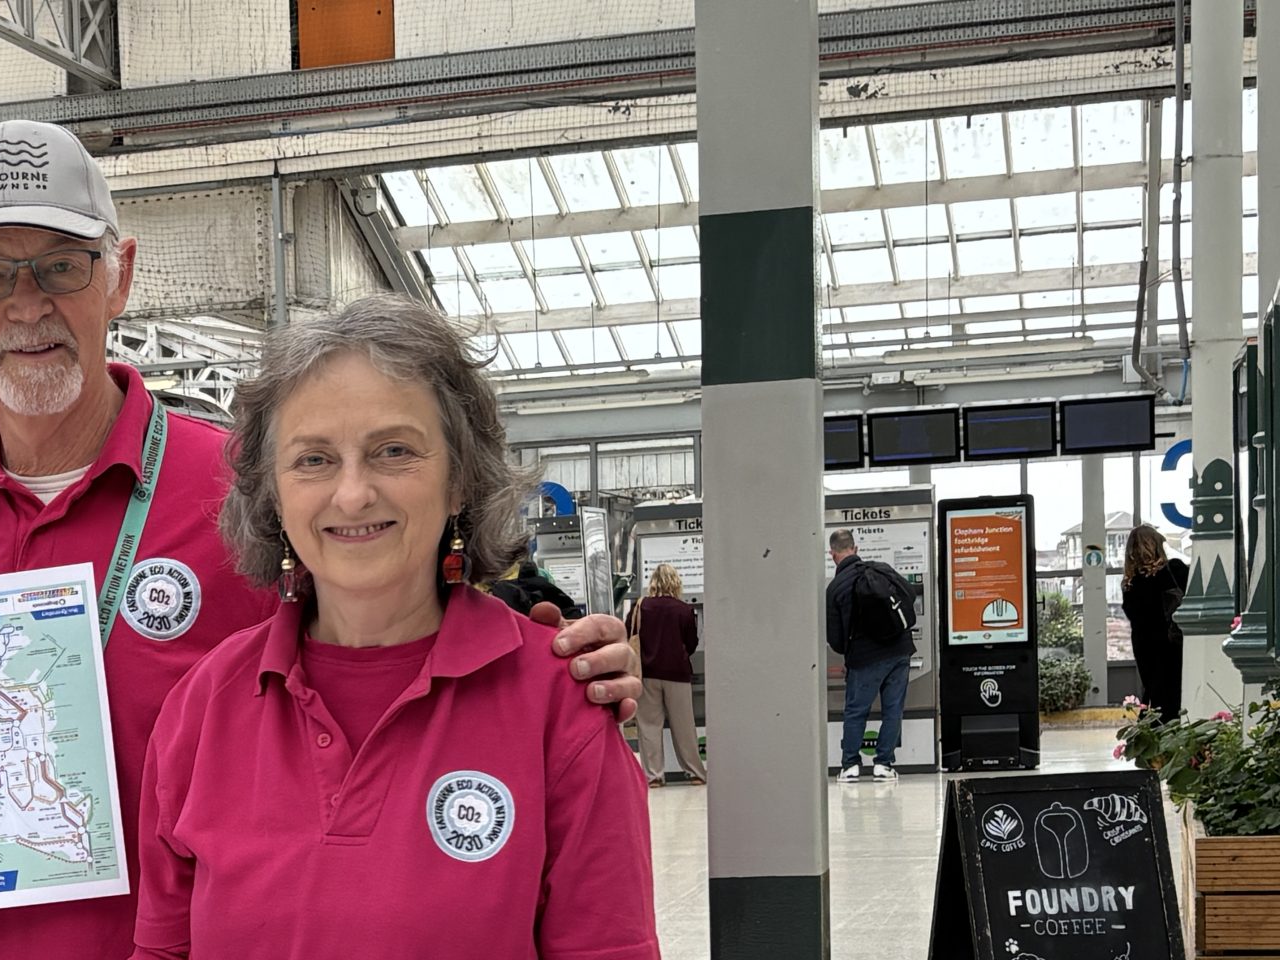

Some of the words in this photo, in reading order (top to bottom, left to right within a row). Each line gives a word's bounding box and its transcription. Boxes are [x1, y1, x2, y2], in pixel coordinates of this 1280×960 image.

[143, 435, 161, 485] EASTBOURNE
[676, 518, 703, 531] Tick
[841, 509, 891, 521] Tickets
[954, 528, 984, 536] Clapham
[985, 526, 1013, 534] Junction
[954, 537, 988, 545] footbridge
[104, 572, 122, 608] ACTION
[115, 533, 135, 574] NETWORK
[149, 565, 165, 575] ECO
[167, 567, 191, 590] ACTION
[126, 571, 149, 613] EASTBOURNE
[173, 591, 193, 625] NETWORK
[137, 611, 171, 631] 2030
[456, 779, 473, 791] ECO
[475, 783, 502, 804] ACTION
[446, 830, 484, 851] 2030
[980, 839, 998, 851] EPIC
[1001, 839, 1026, 852] COFFEE
[1007, 885, 1135, 917] FOUNDRY
[1034, 918, 1107, 936] COFFEE
